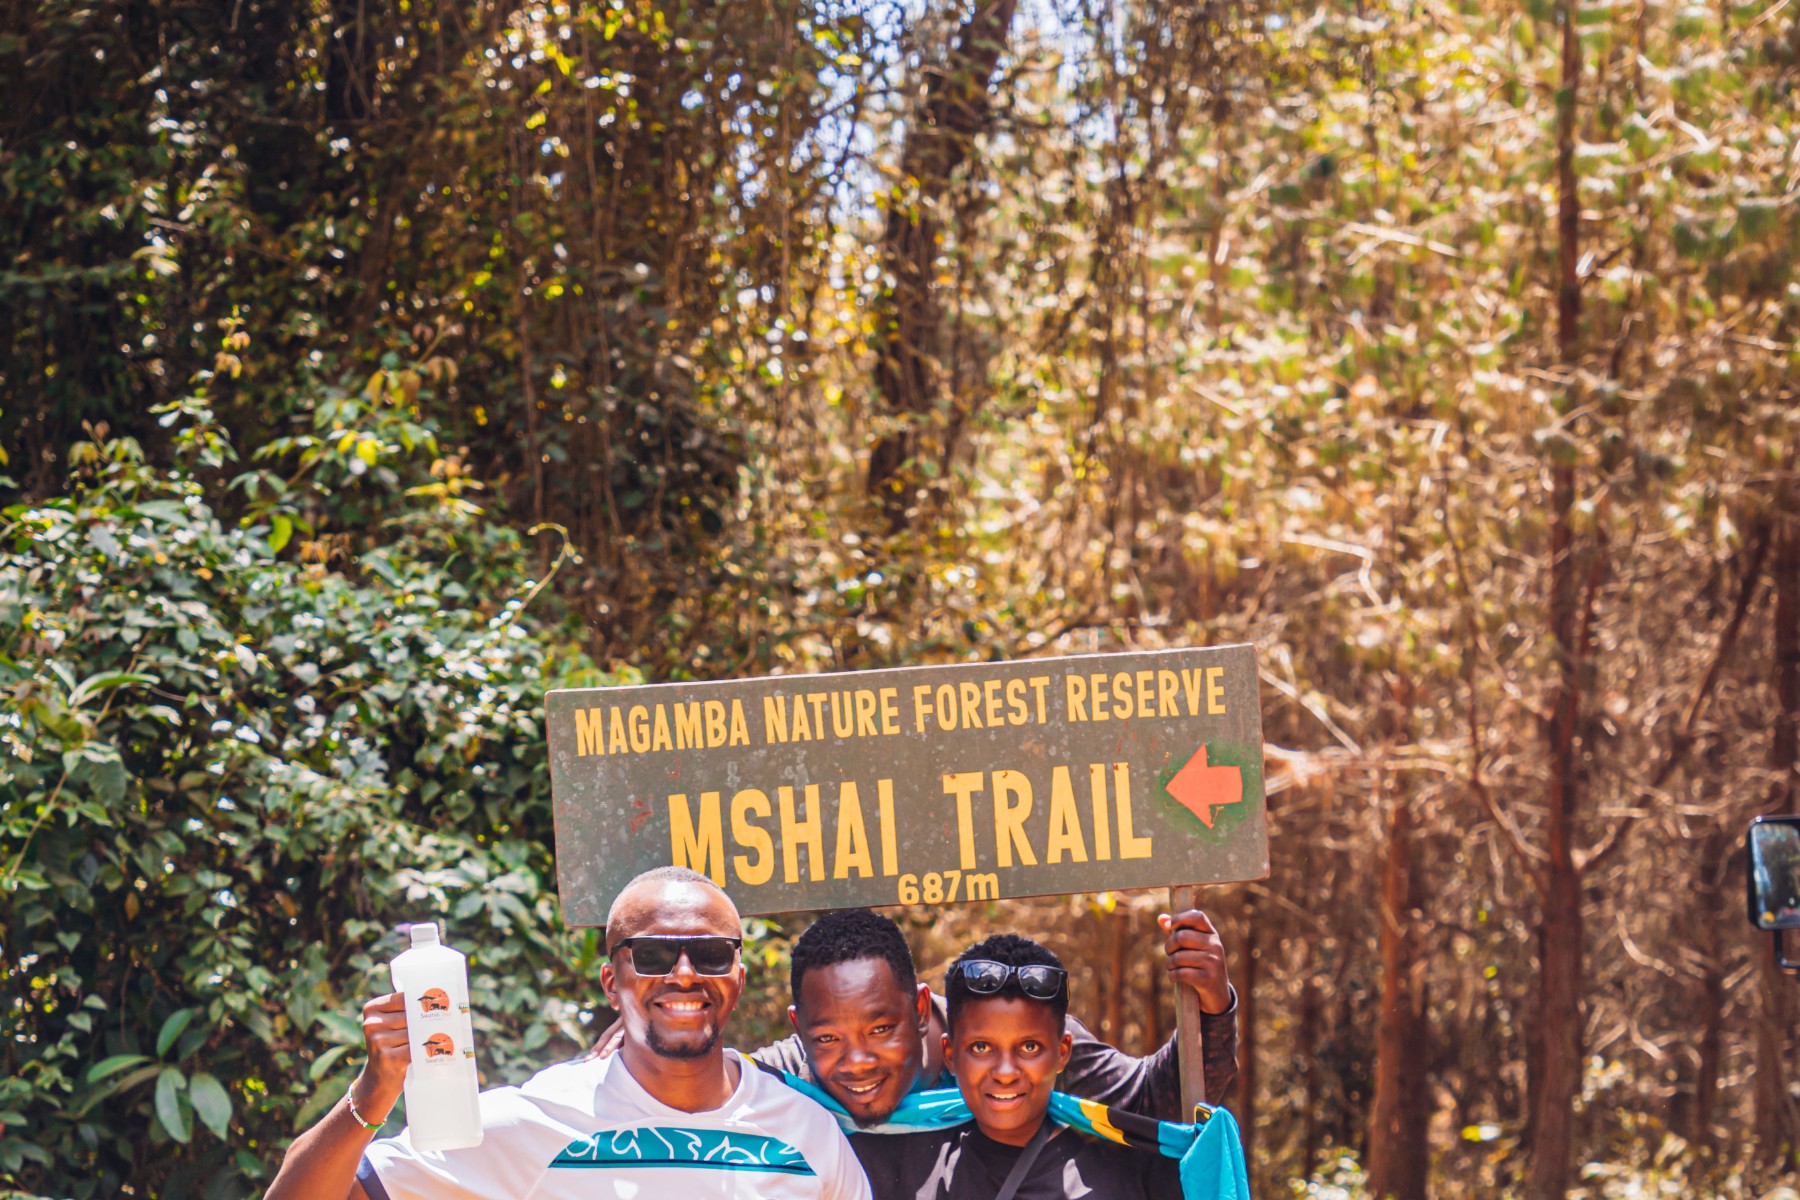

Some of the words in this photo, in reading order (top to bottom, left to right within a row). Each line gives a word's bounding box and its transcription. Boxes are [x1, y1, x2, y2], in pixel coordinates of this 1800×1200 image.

[575, 698, 751, 757] MAGAMBA
[763, 686, 901, 745] NATURE
[913, 675, 1051, 734] FOREST
[1065, 666, 1227, 723] RESERVE
[667, 778, 899, 889] MSHAI
[941, 761, 1153, 871] TRAIL
[897, 869, 1000, 906] 687m
